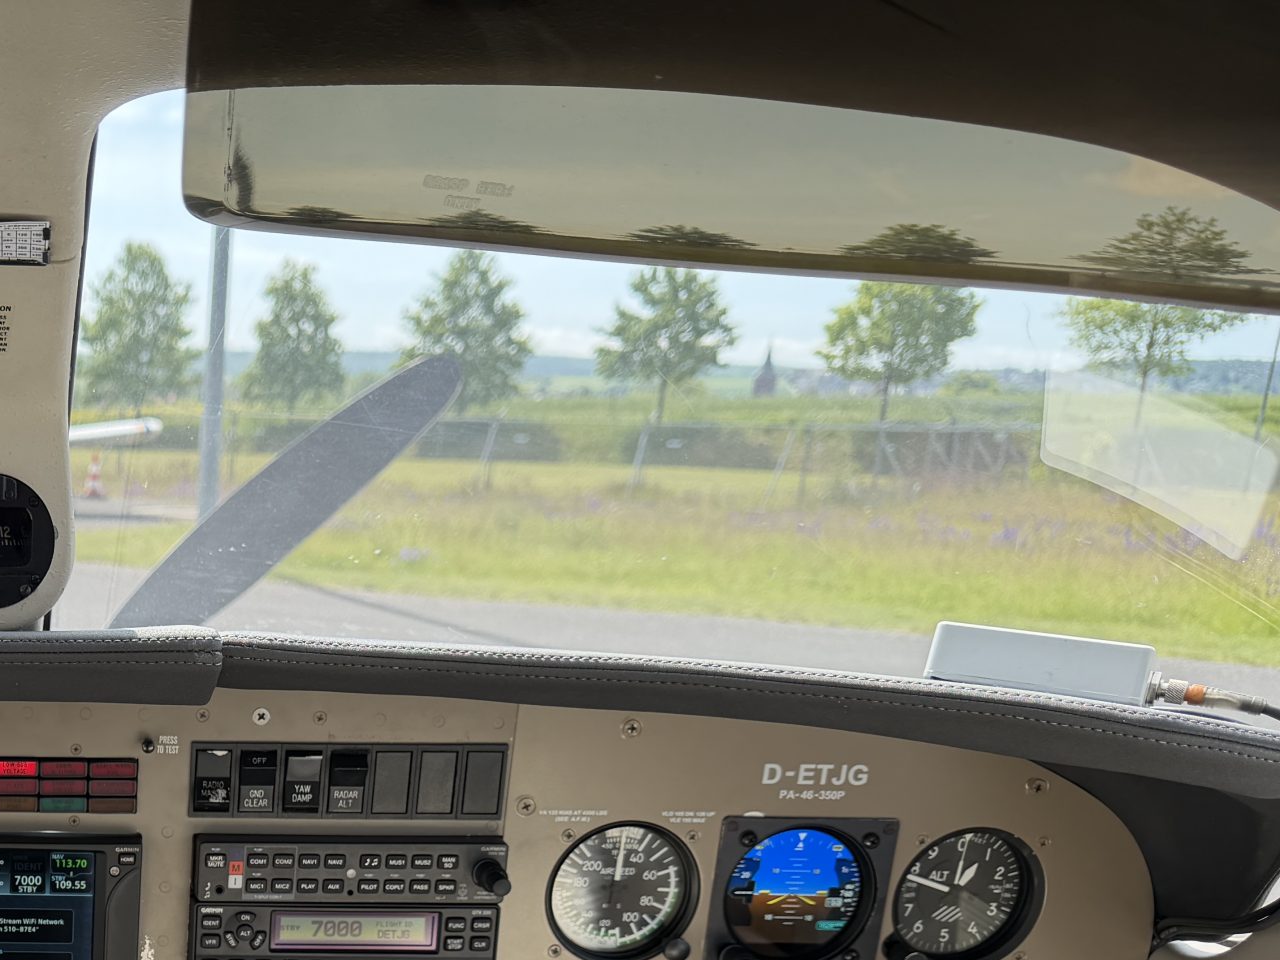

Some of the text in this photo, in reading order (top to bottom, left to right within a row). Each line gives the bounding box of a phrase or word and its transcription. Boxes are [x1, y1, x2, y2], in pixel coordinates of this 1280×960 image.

[0, 526, 11, 538] 12
[159, 736, 178, 744] PRESS
[157, 746, 179, 754] TO TEST
[252, 757, 267, 765] OFF
[762, 764, 869, 786] D-ETJG
[249, 789, 264, 798] GND
[294, 785, 311, 794] YAW
[292, 793, 313, 802] DAMP
[333, 791, 358, 799] RADAR
[779, 790, 845, 800] PA-46-350P
[244, 798, 268, 807] CLEAR
[338, 798, 353, 808] ALT
[55, 859, 87, 869] 113.70
[929, 870, 950, 881] ALT
[14, 876, 42, 886] 7000
[55, 881, 86, 890] 109.55
[312, 920, 362, 937] 7000
[378, 930, 410, 939] DETJG
